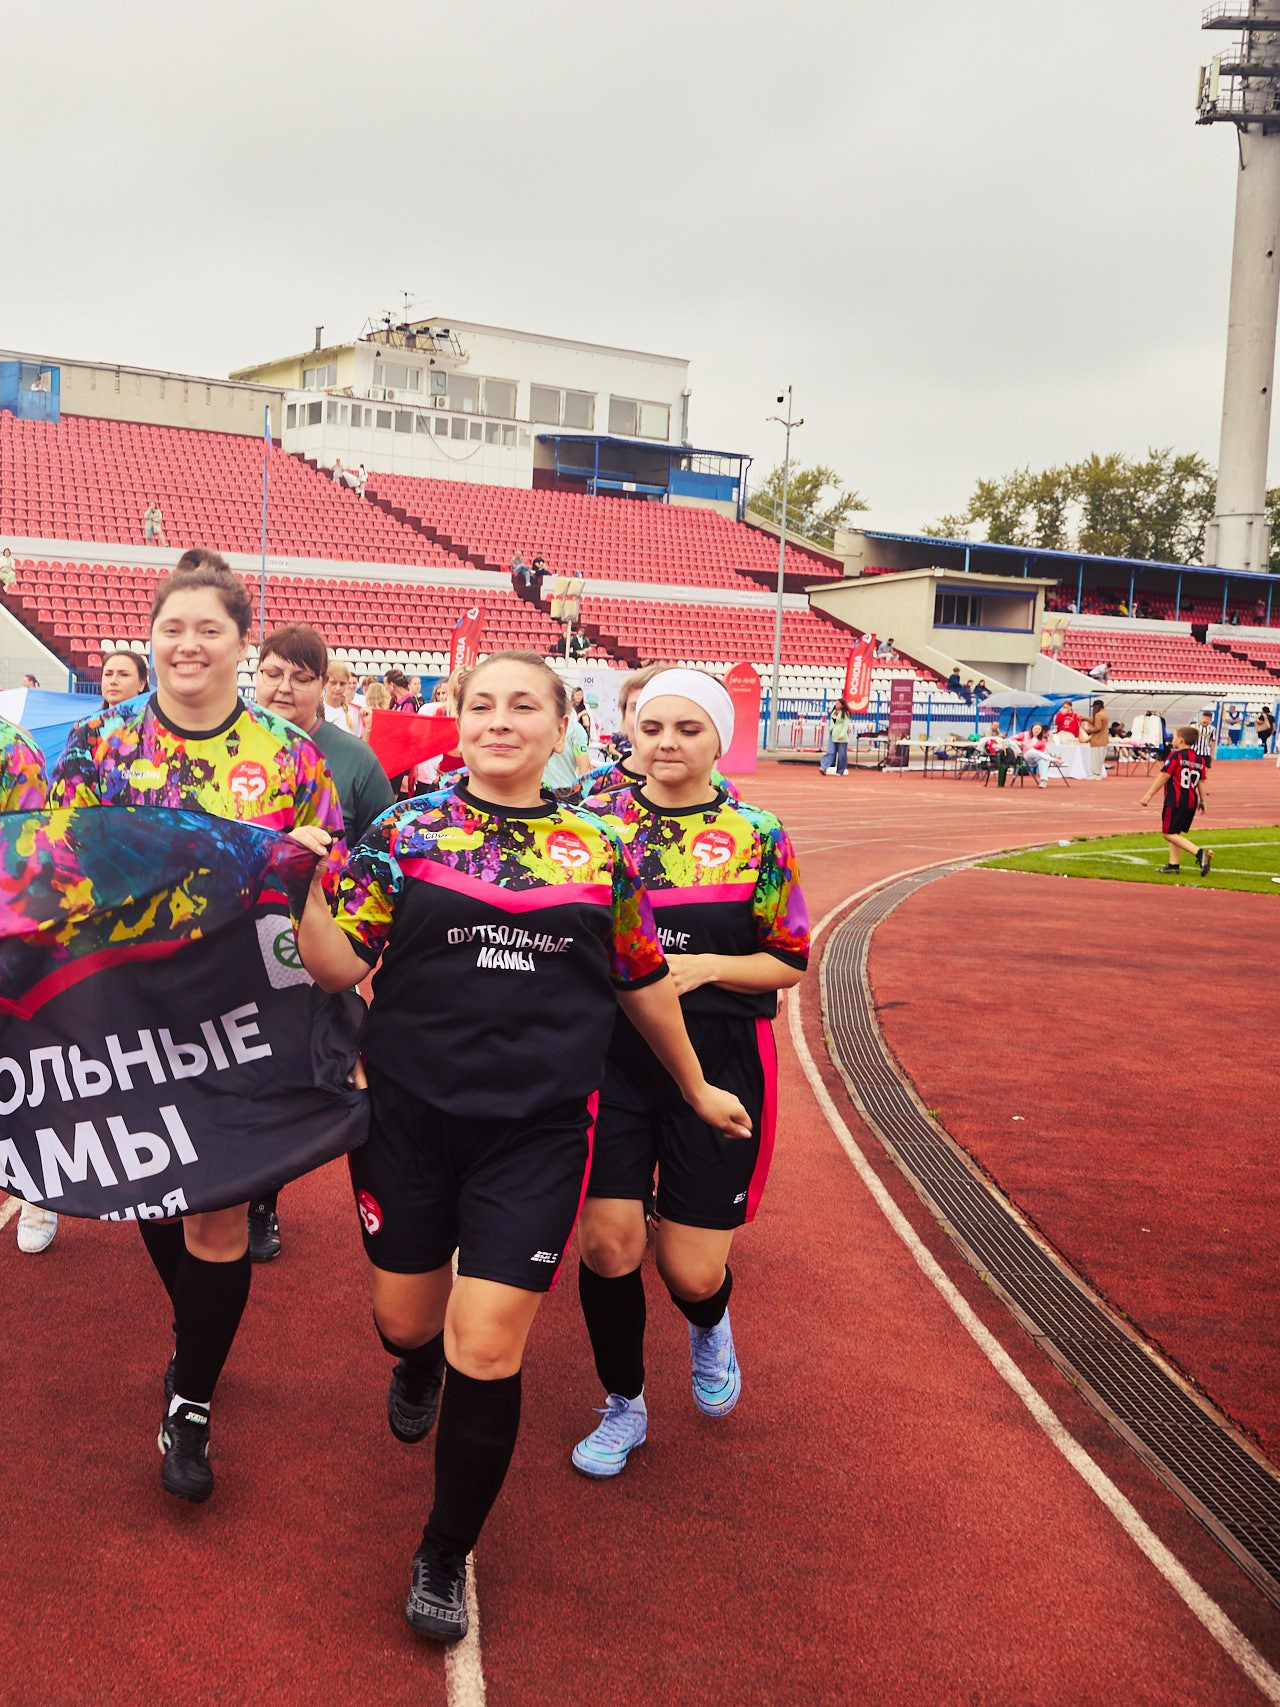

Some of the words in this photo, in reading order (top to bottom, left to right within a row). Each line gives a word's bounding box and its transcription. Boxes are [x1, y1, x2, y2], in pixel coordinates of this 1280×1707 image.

[454, 636, 467, 668] НОВА
[849, 655, 863, 696] ОСНОВА
[231, 776, 267, 801] 52
[550, 845, 591, 867] 52
[691, 842, 731, 868] 52
[447, 925, 574, 953] ФУТБОЛЬНЫЕ
[656, 926, 691, 951] НЫЕ
[476, 946, 536, 972] МАМЫ
